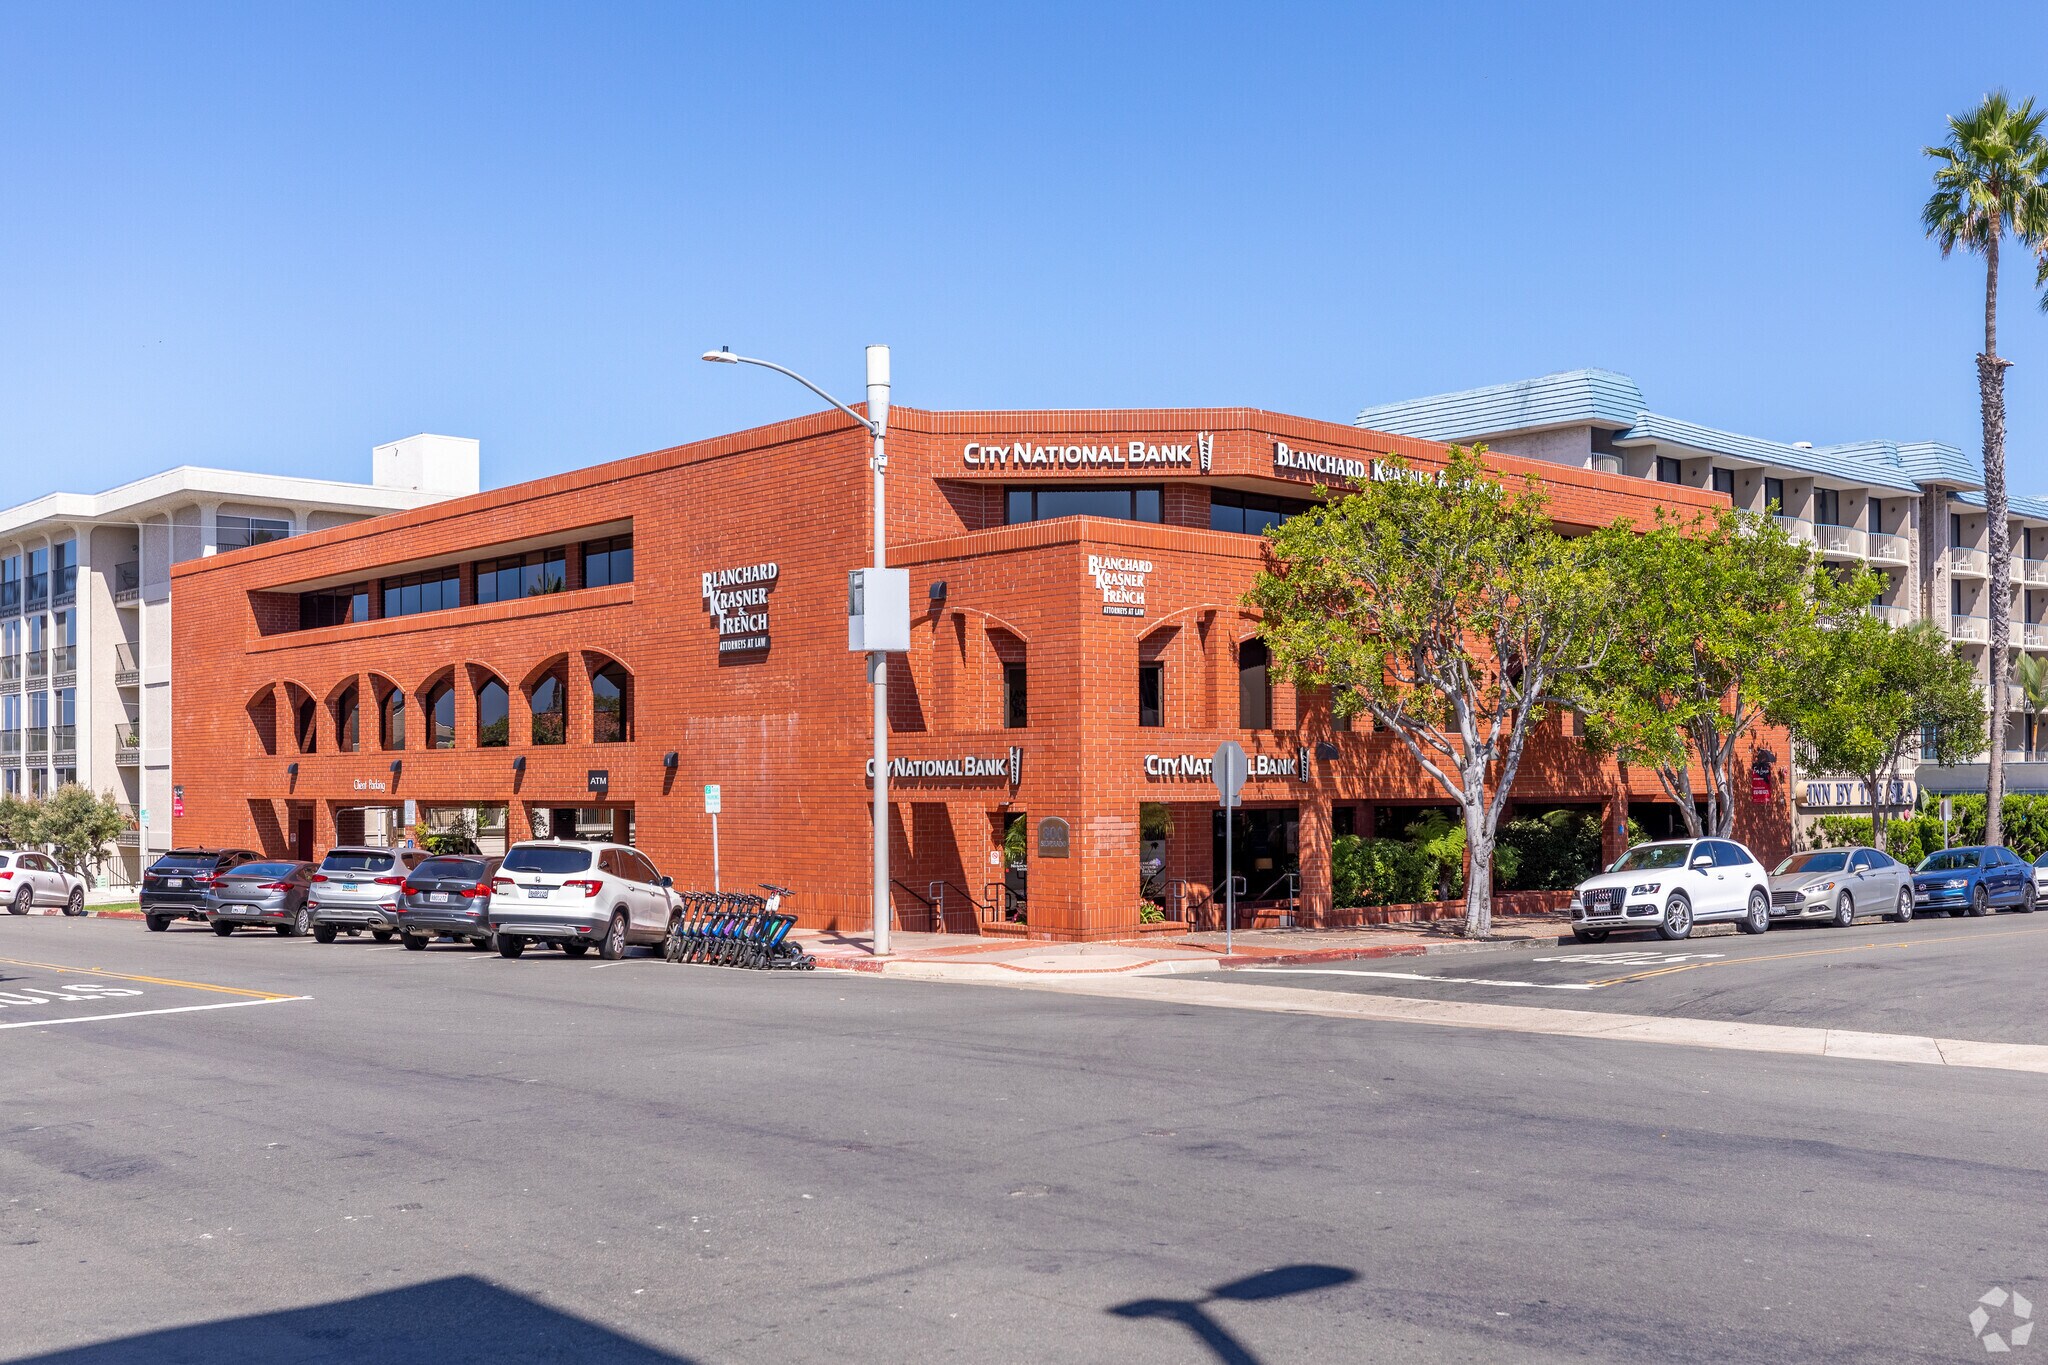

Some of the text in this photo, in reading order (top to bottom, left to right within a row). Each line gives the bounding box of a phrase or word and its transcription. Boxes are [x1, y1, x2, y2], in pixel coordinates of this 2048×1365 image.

[964, 442, 1192, 463] CITY NATIONAL BANK
[1088, 555, 1153, 575] BLANCHARD
[702, 562, 778, 598] BLANCHARD
[1096, 570, 1144, 589] KRASNER
[710, 588, 768, 616] KRASNER
[1104, 586, 1145, 605] FRENCH
[738, 607, 748, 616] &
[719, 609, 768, 635] FRENCH
[719, 637, 766, 651] ATTORNEYS AT LAW
[866, 757, 1006, 777] CY NATIONAL BANK
[1147, 755, 1180, 775] CITY
[1257, 755, 1296, 775] BANK
[354, 779, 385, 793] Client Parking
[590, 777, 606, 785] ATM
[1807, 783, 1831, 806] INN
[1836, 783, 1853, 805] BY
